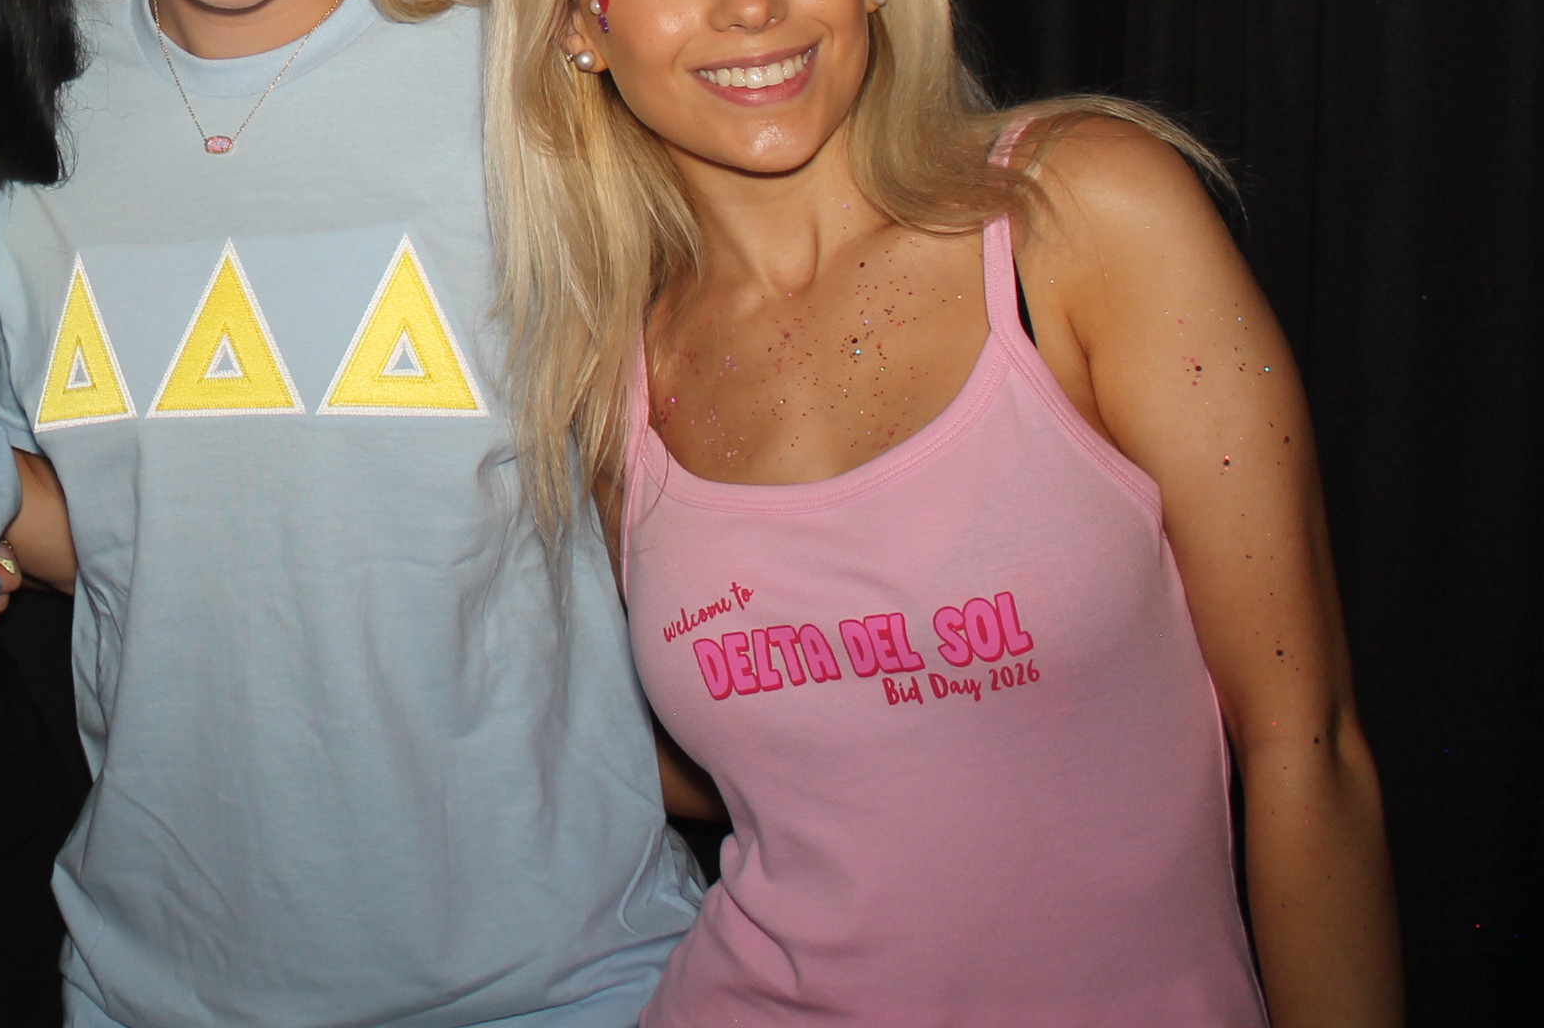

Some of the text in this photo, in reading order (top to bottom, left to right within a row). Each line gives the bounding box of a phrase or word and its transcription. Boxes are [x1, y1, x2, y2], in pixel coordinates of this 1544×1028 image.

[663, 581, 754, 643] welcome to
[693, 591, 1034, 701] DELTA DEL SOL
[882, 659, 1040, 705] Bid Day 2026
